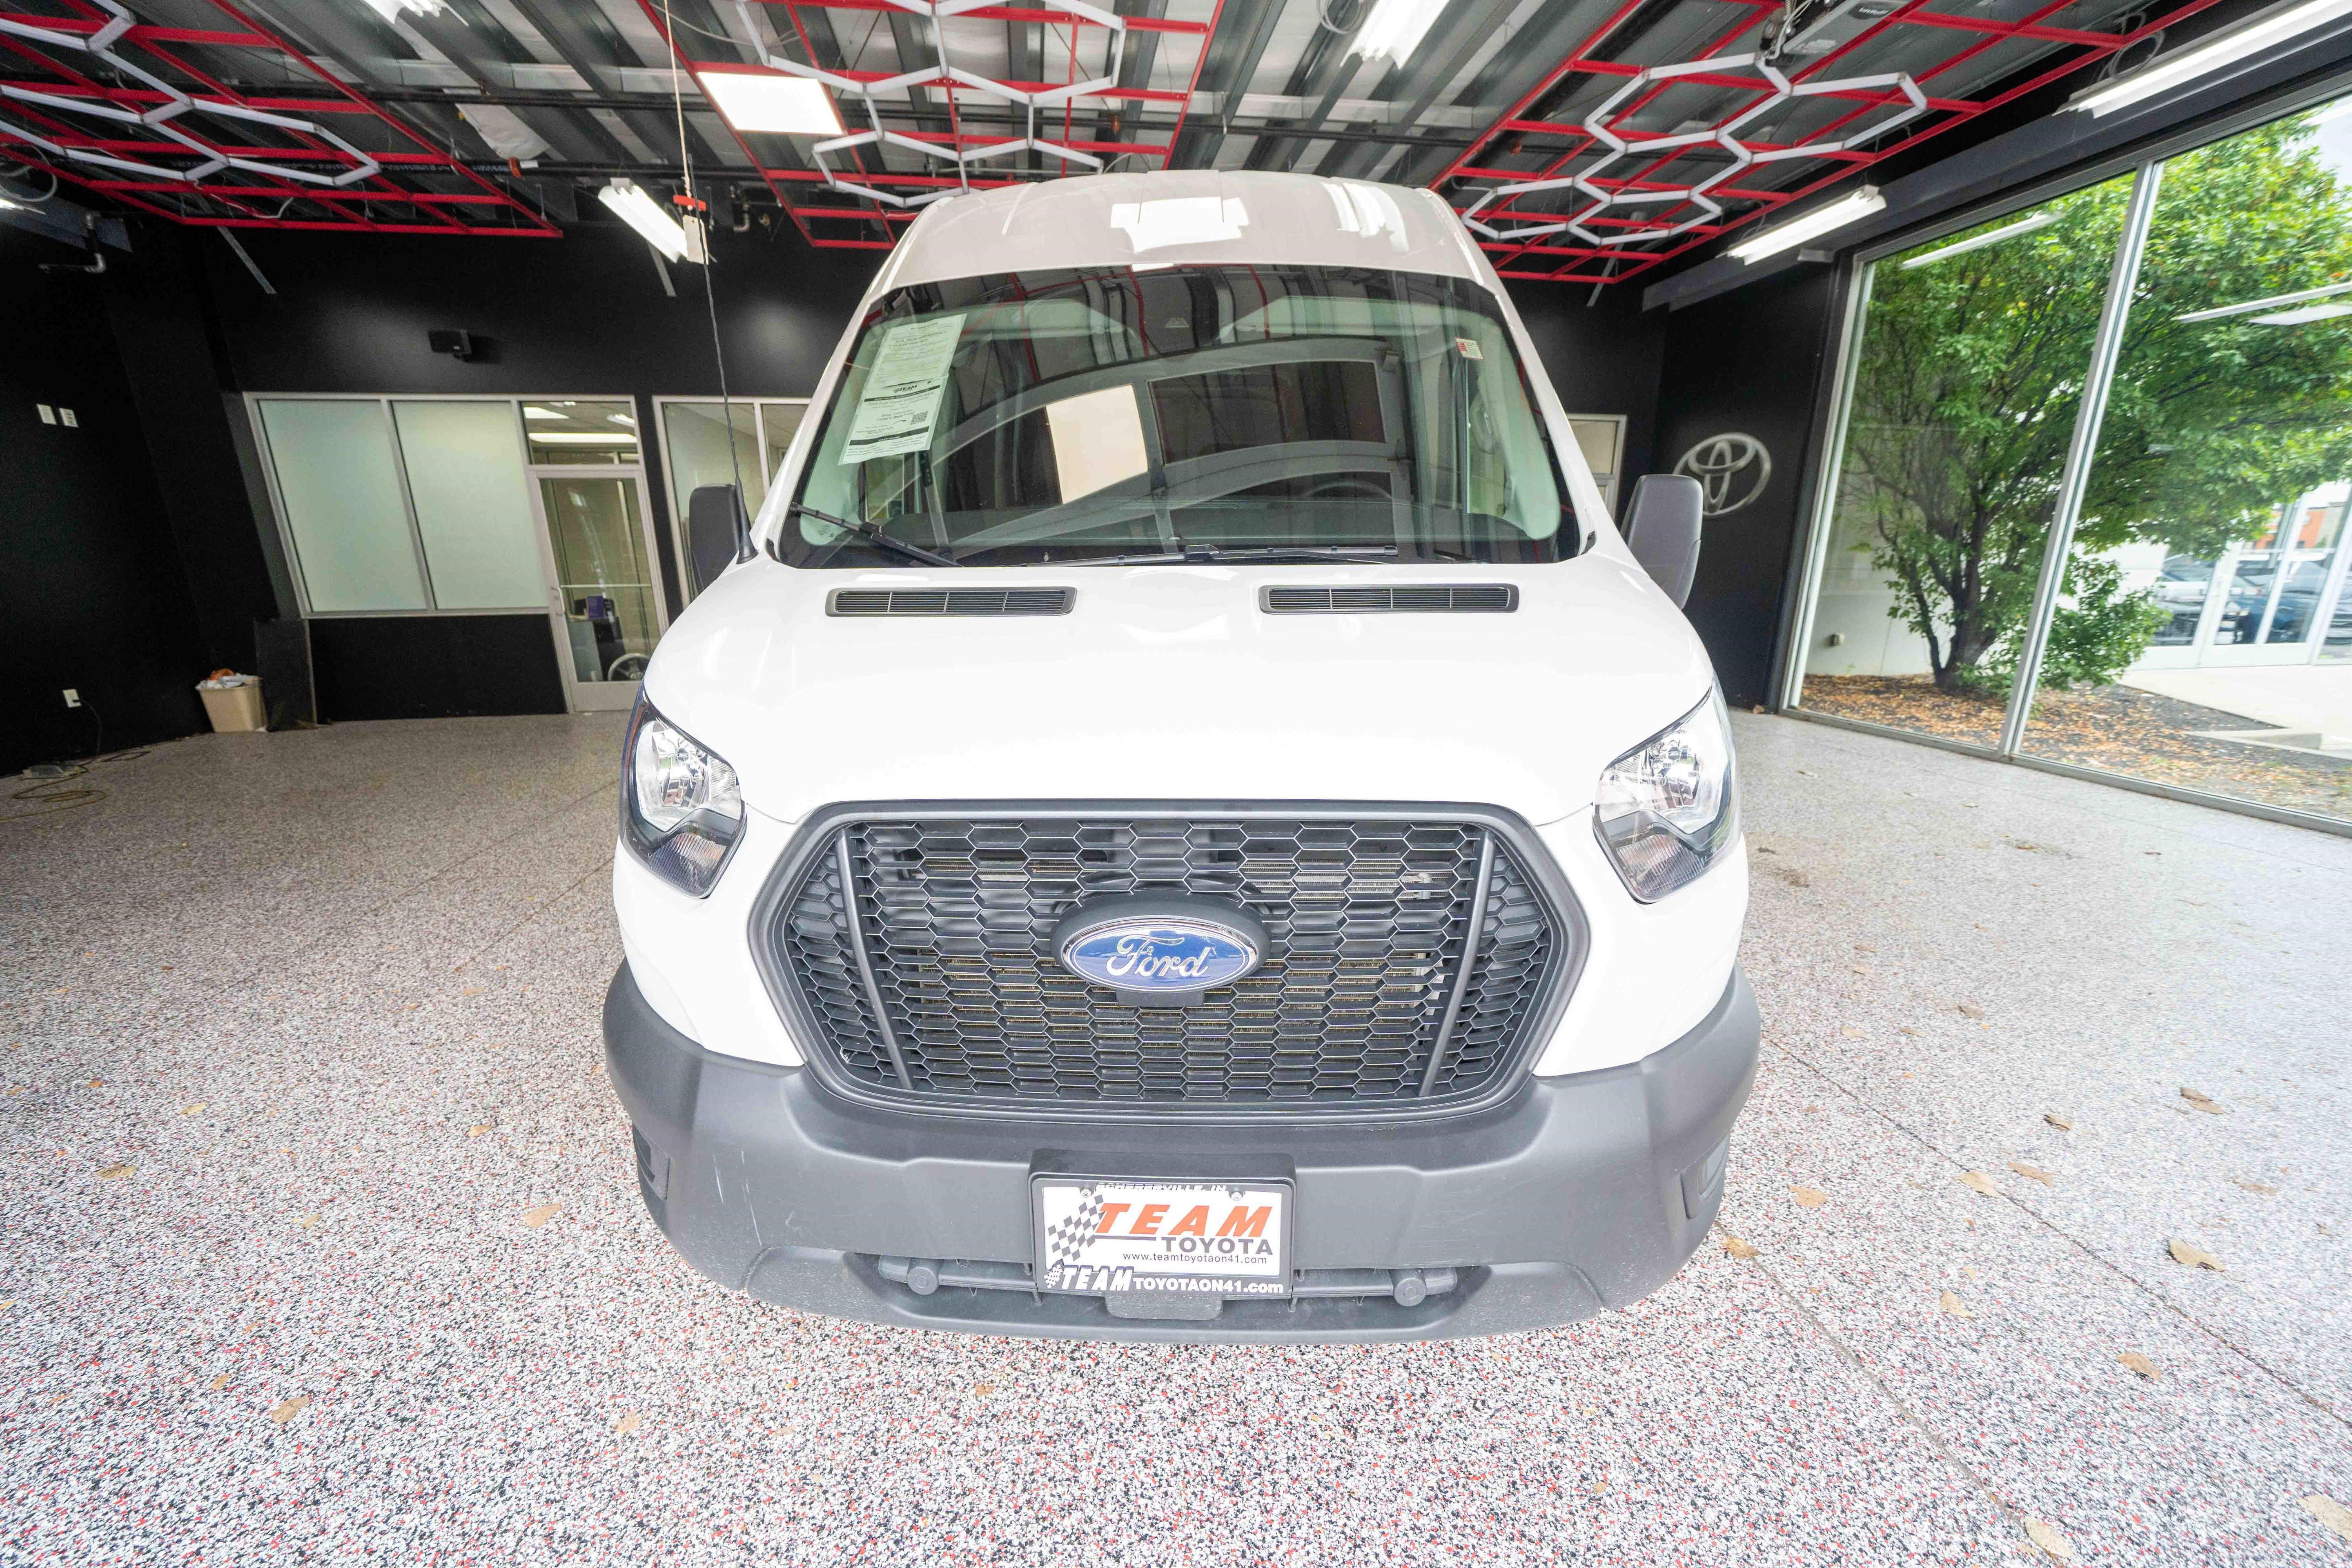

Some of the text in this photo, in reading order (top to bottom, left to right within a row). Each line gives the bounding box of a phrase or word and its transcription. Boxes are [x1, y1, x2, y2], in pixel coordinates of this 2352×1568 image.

[1106, 934, 1209, 976] Ford
[1096, 1203, 1272, 1237] TEAM
[1123, 1253, 1267, 1264] www.teamtoyotaon41.com
[1161, 1237, 1273, 1255] TOYOTA
[1062, 1267, 1283, 1293] TEAM TOYOTAON41.com
